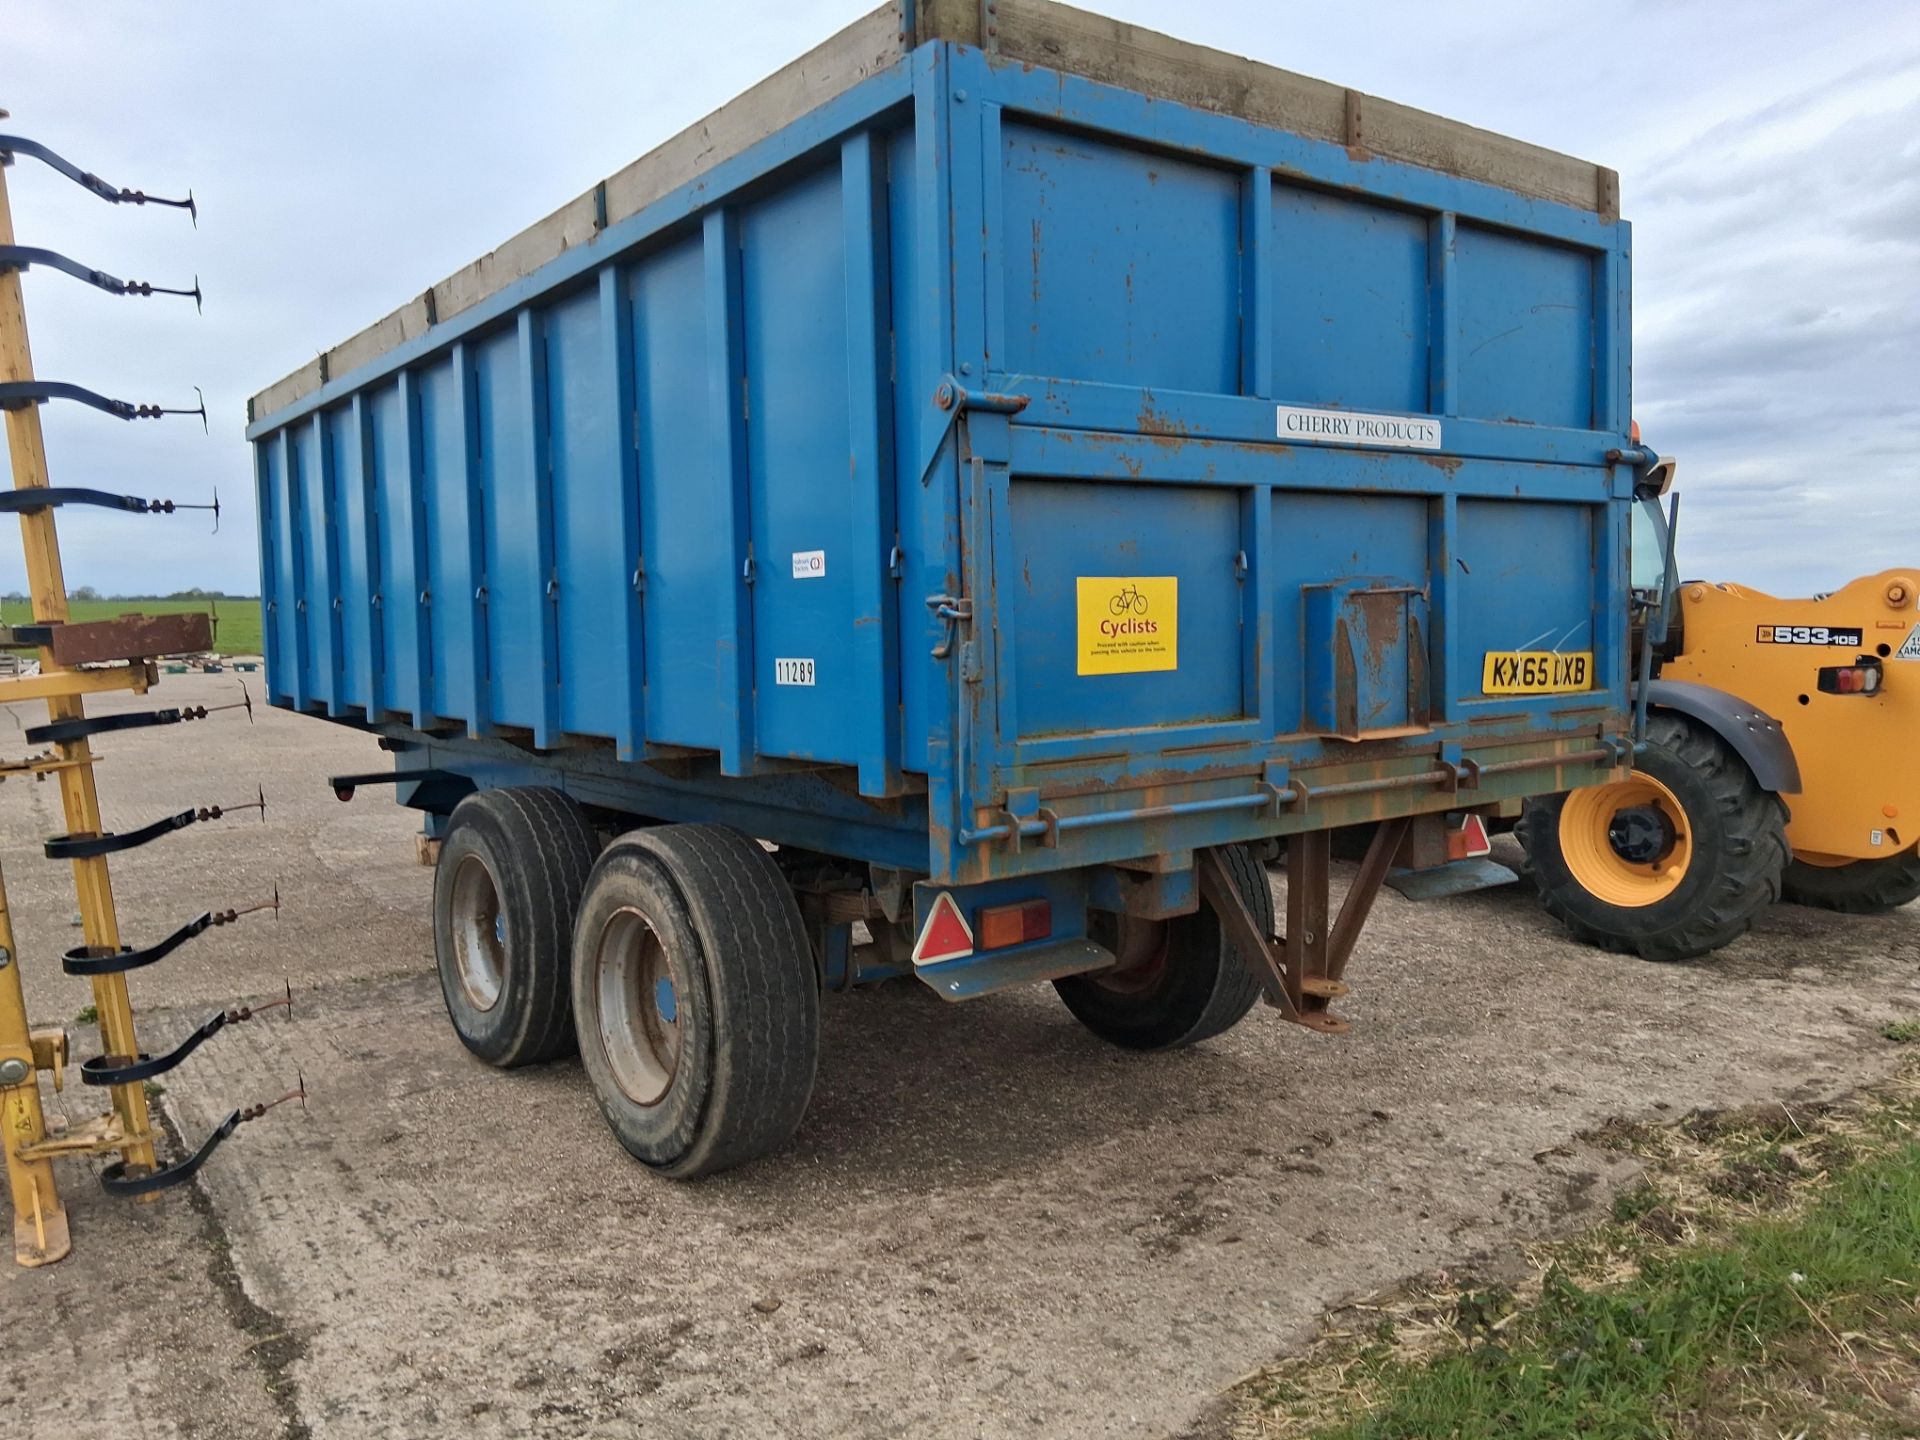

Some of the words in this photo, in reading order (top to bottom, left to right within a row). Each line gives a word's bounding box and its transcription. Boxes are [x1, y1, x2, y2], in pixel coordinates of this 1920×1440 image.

[1286, 413, 1351, 435] CHERRY
[1356, 419, 1434, 441] PRODUCTS
[1100, 618, 1158, 639] Cyclists
[778, 661, 813, 683] 11289
[1492, 657, 1548, 687] KX65
